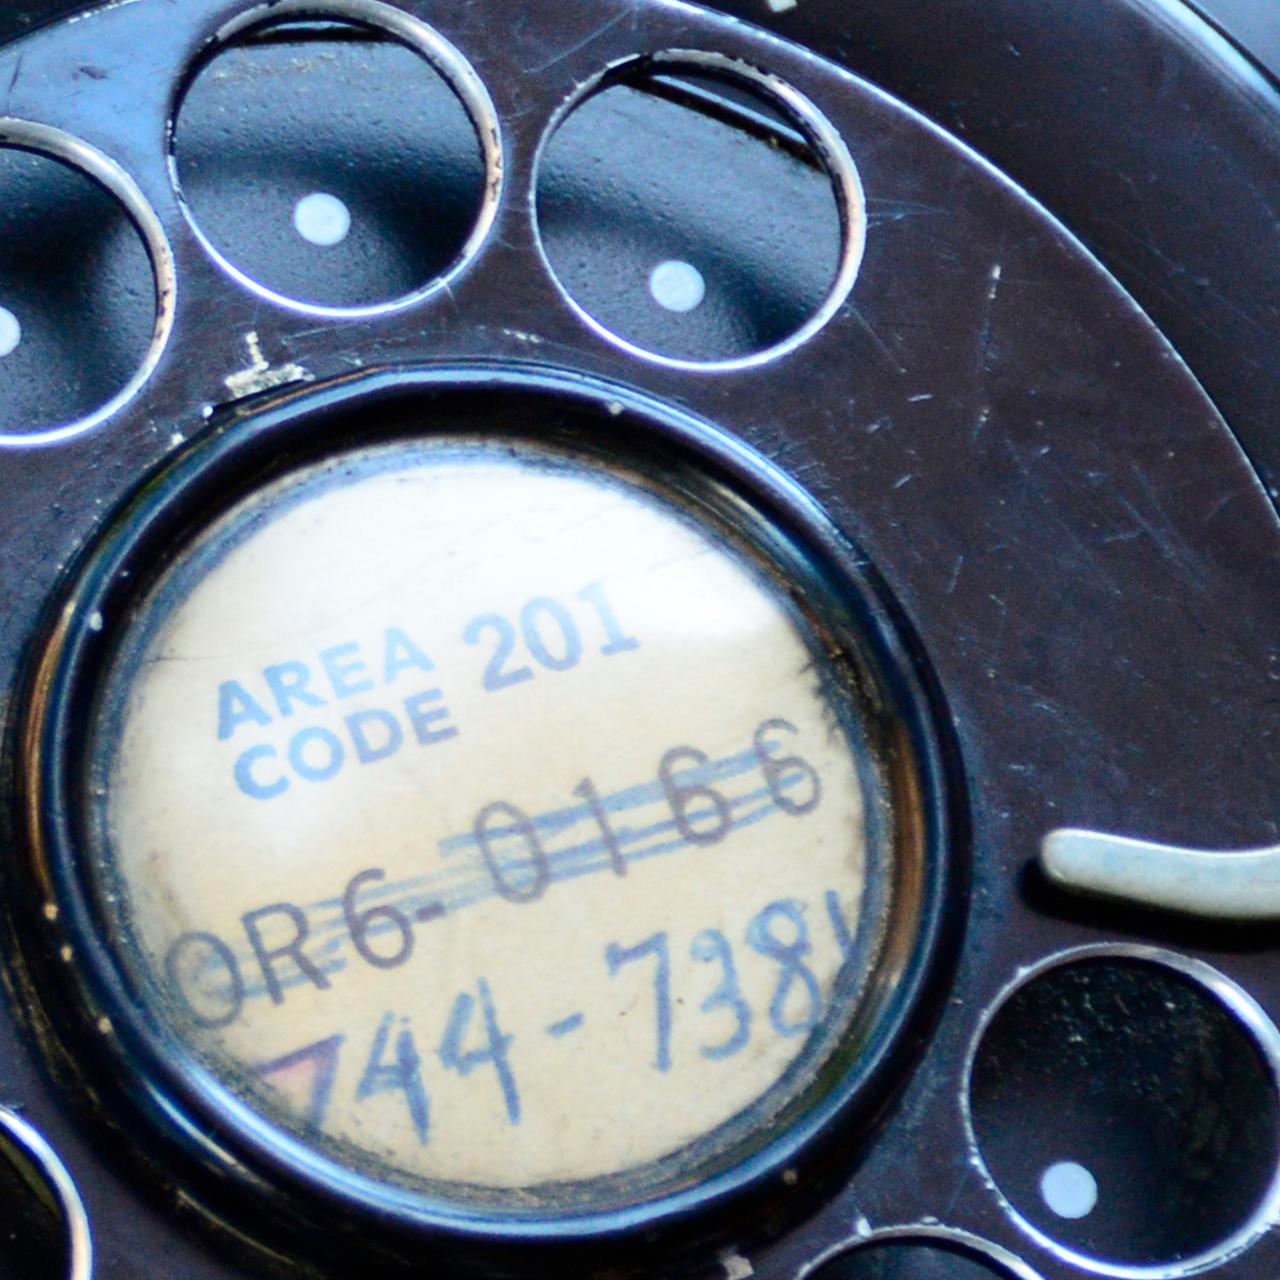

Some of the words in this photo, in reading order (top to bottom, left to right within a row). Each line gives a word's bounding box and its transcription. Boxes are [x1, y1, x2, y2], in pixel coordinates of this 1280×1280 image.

[216, 627, 436, 742] AREA
[462, 579, 641, 694] 201
[233, 687, 460, 800] CODE
